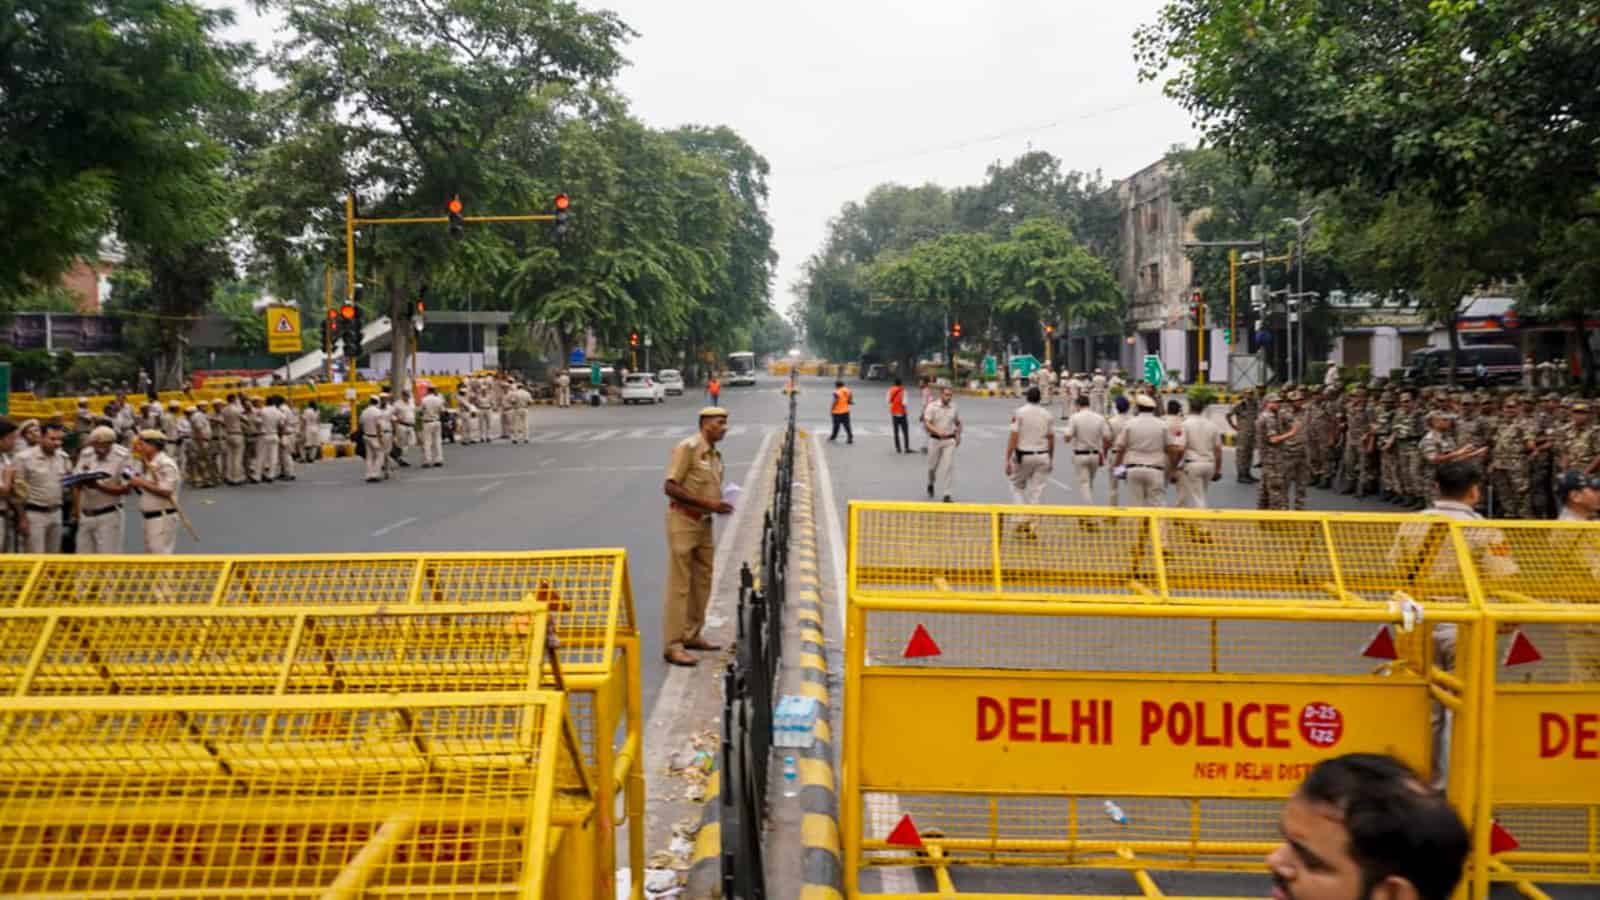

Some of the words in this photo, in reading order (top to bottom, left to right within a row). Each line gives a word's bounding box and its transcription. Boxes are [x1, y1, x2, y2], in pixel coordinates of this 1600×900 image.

[976, 696, 1113, 745] DELHI
[1140, 700, 1292, 749] POLICE
[1193, 762, 1229, 780] NEW
